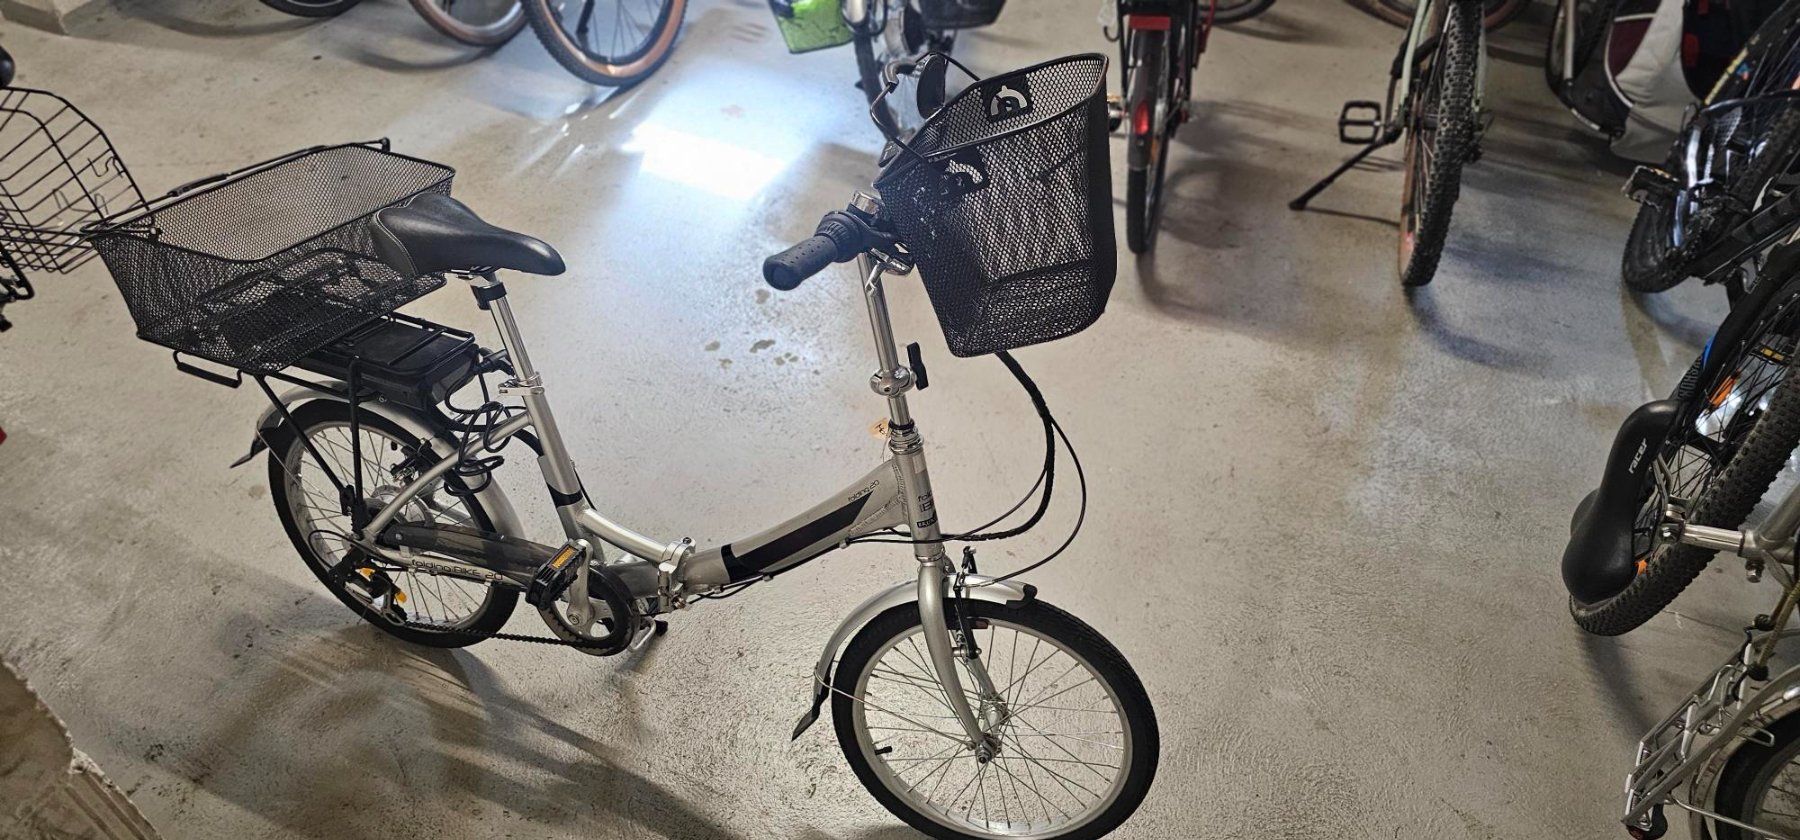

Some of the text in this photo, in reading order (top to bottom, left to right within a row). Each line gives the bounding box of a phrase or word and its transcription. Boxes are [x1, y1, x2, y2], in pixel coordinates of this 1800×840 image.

[1628, 437, 1647, 474] racer
[411, 559, 452, 573] folding
[485, 571, 503, 581] 20
